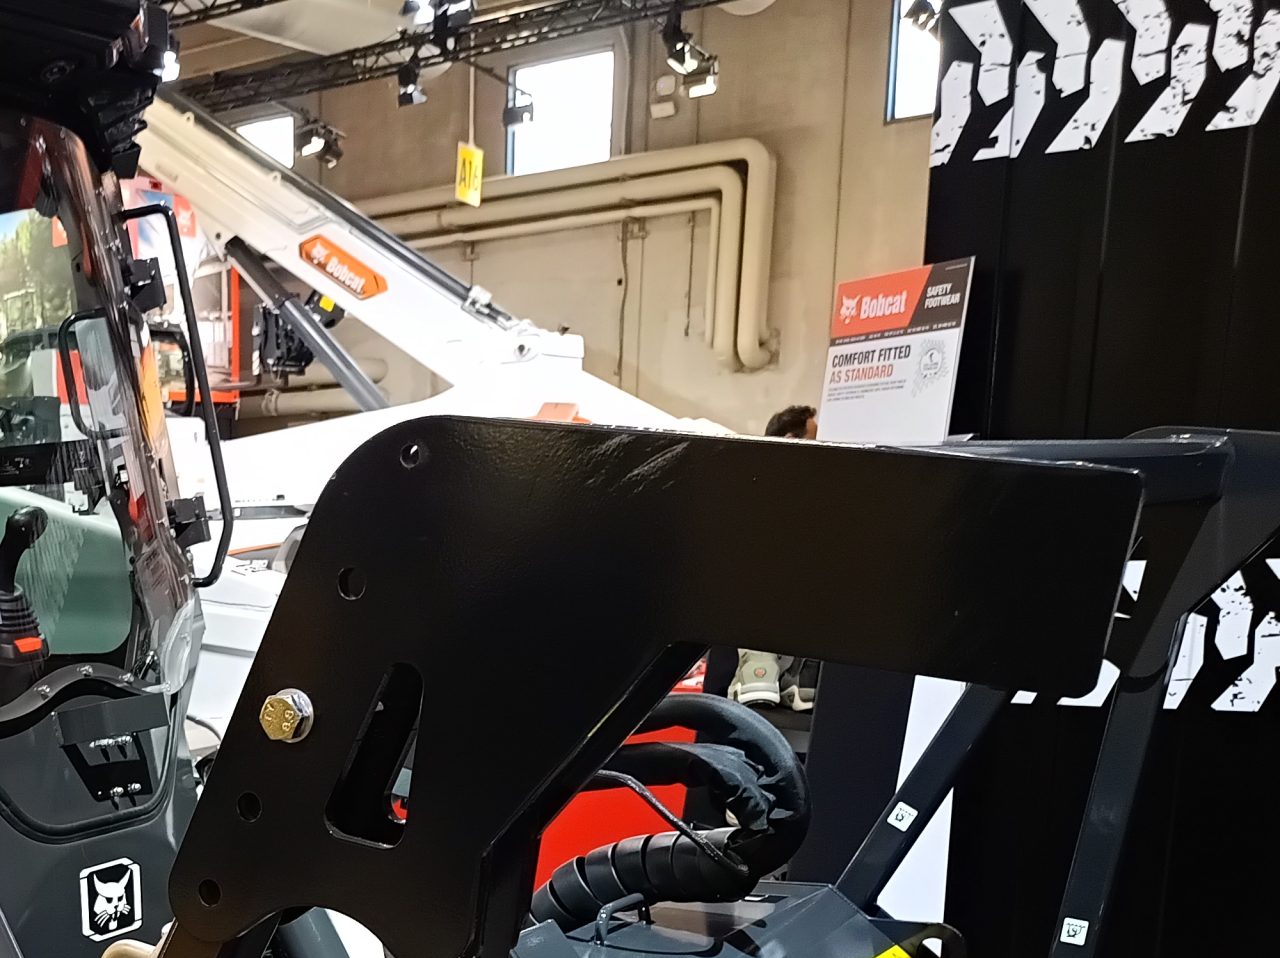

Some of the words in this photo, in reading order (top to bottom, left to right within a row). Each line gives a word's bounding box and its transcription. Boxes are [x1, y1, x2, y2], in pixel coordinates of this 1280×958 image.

[325, 256, 366, 294] Bobcat
[924, 292, 960, 309] FOOTWEAR
[926, 282, 953, 298] SAFETY
[860, 290, 908, 320] Bobcat
[832, 349, 876, 368] COMFORT
[877, 344, 911, 362] FITTED
[829, 369, 842, 384] AS
[844, 363, 894, 383] STANDARD
